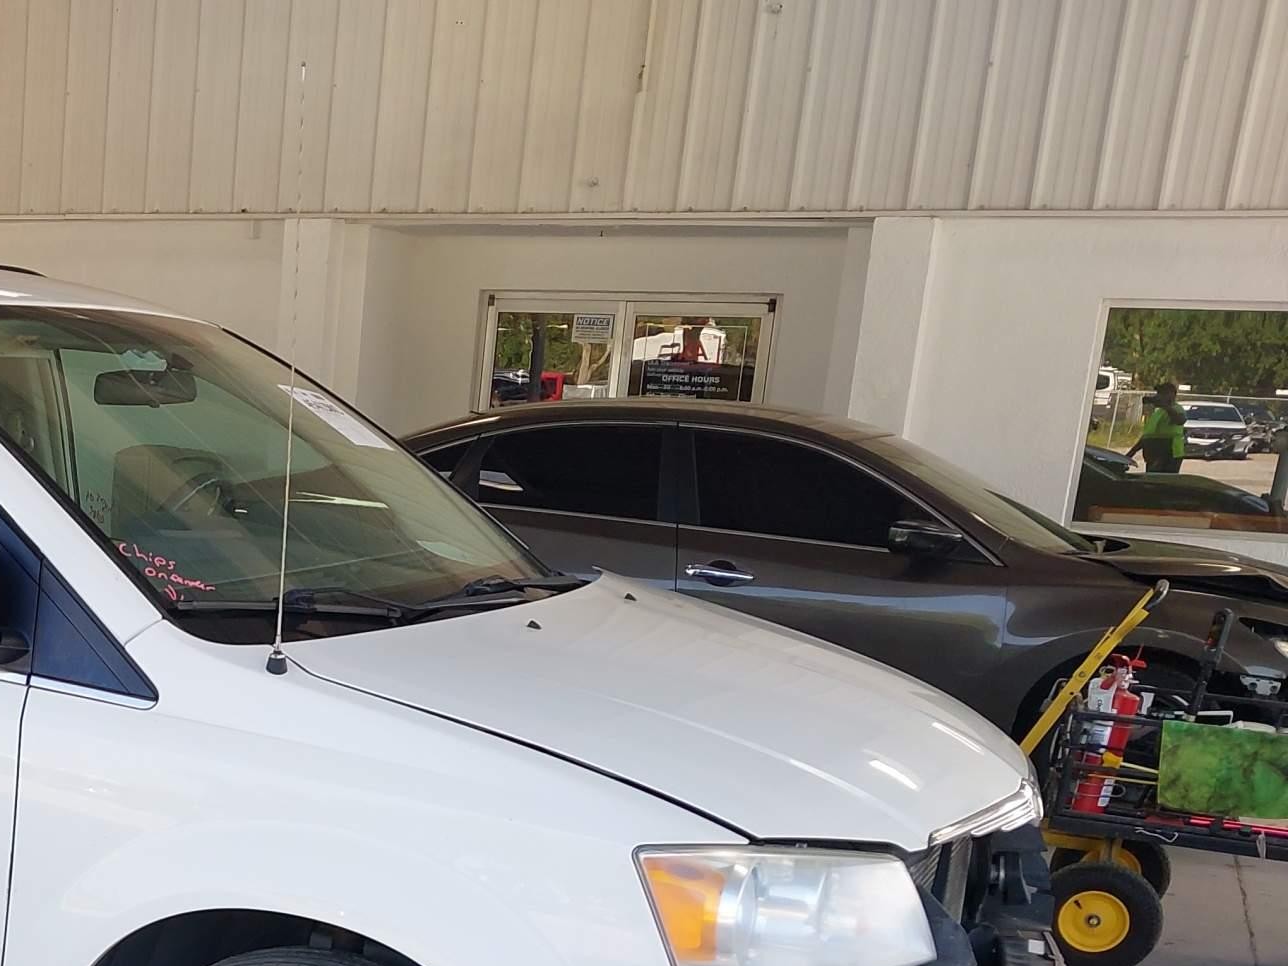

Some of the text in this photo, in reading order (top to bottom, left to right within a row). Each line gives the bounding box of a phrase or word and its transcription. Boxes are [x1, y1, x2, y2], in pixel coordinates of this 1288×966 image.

[577, 317, 609, 326] NOTICE
[662, 374, 689, 383] OFFICE
[691, 376, 720, 384] HOURS
